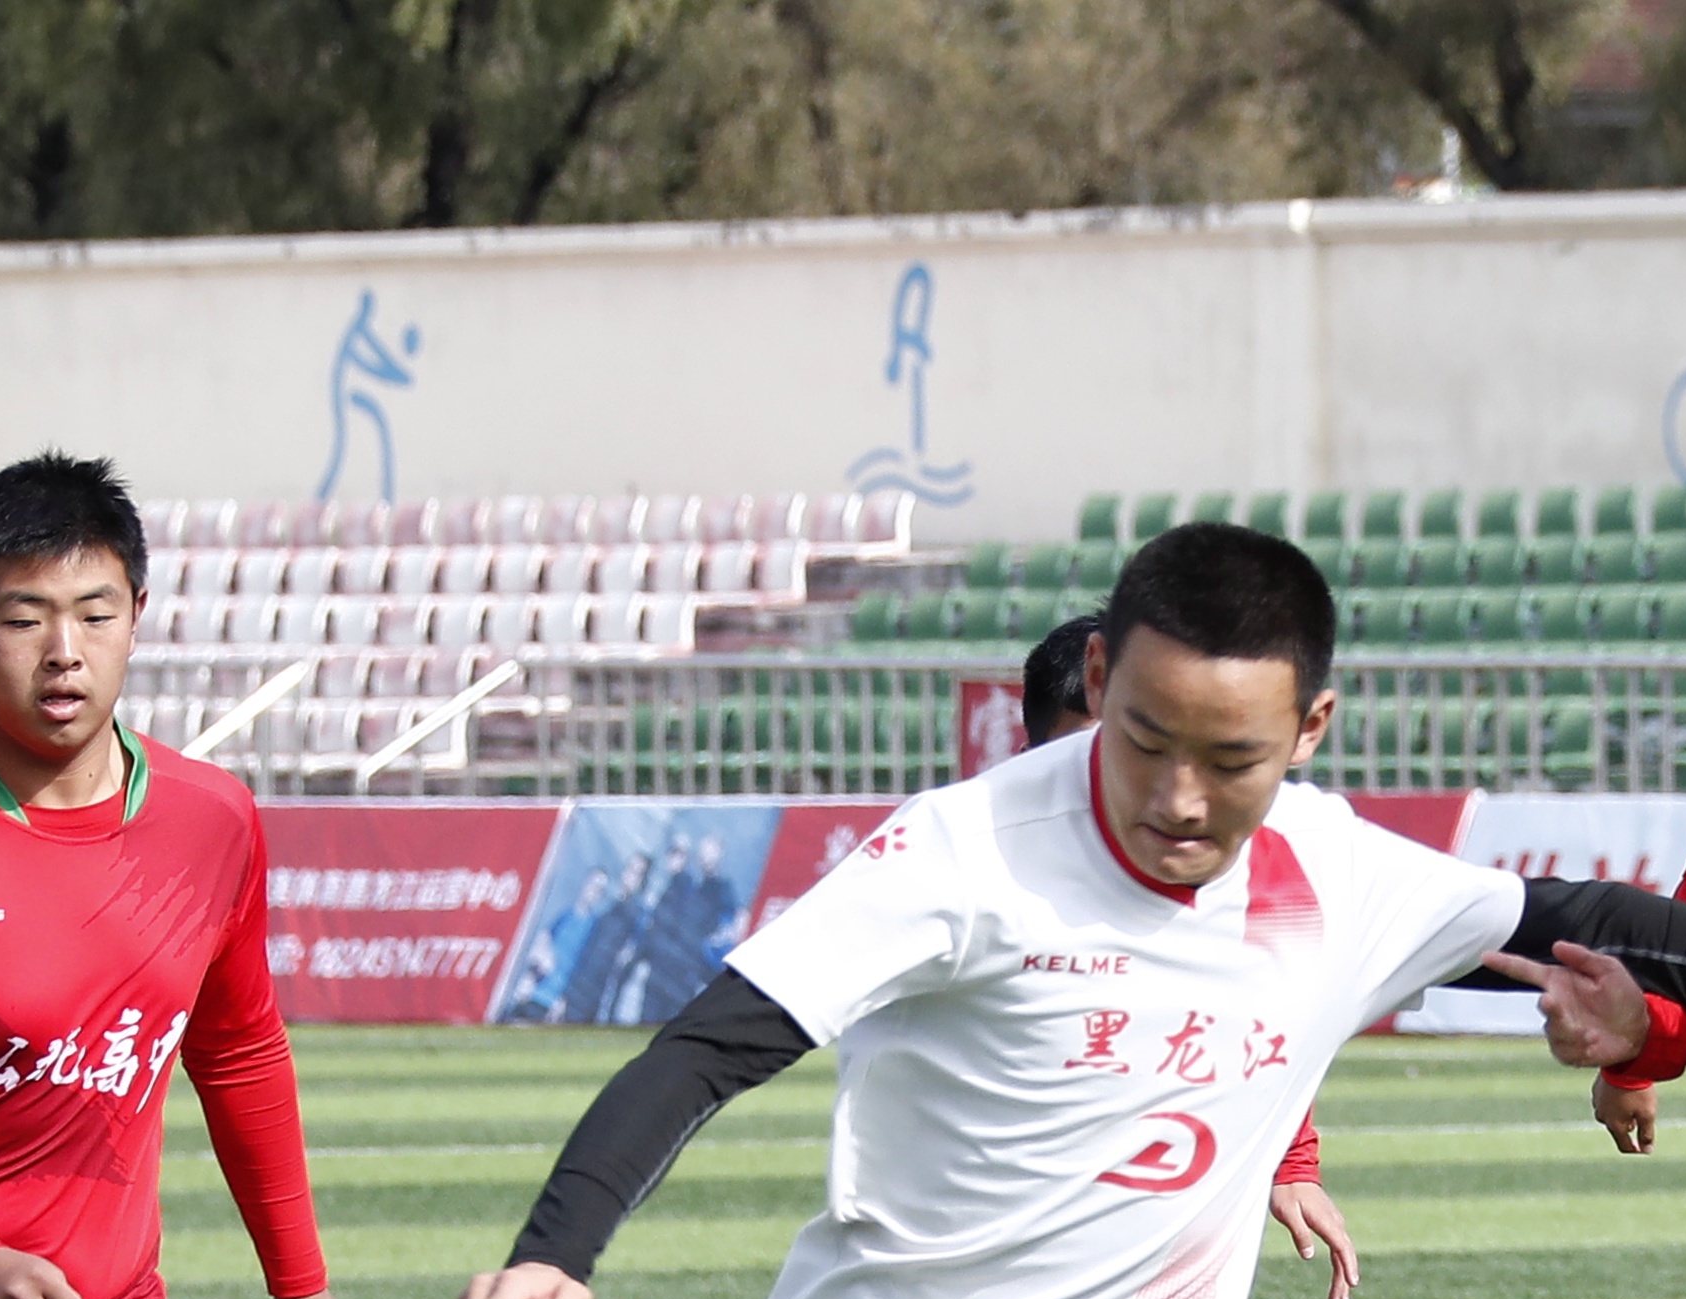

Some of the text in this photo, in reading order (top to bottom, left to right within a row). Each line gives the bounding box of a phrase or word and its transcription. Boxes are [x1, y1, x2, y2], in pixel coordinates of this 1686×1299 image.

[1021, 954, 1132, 976] KELME
[1063, 1009, 1288, 1084] 黑龙江
